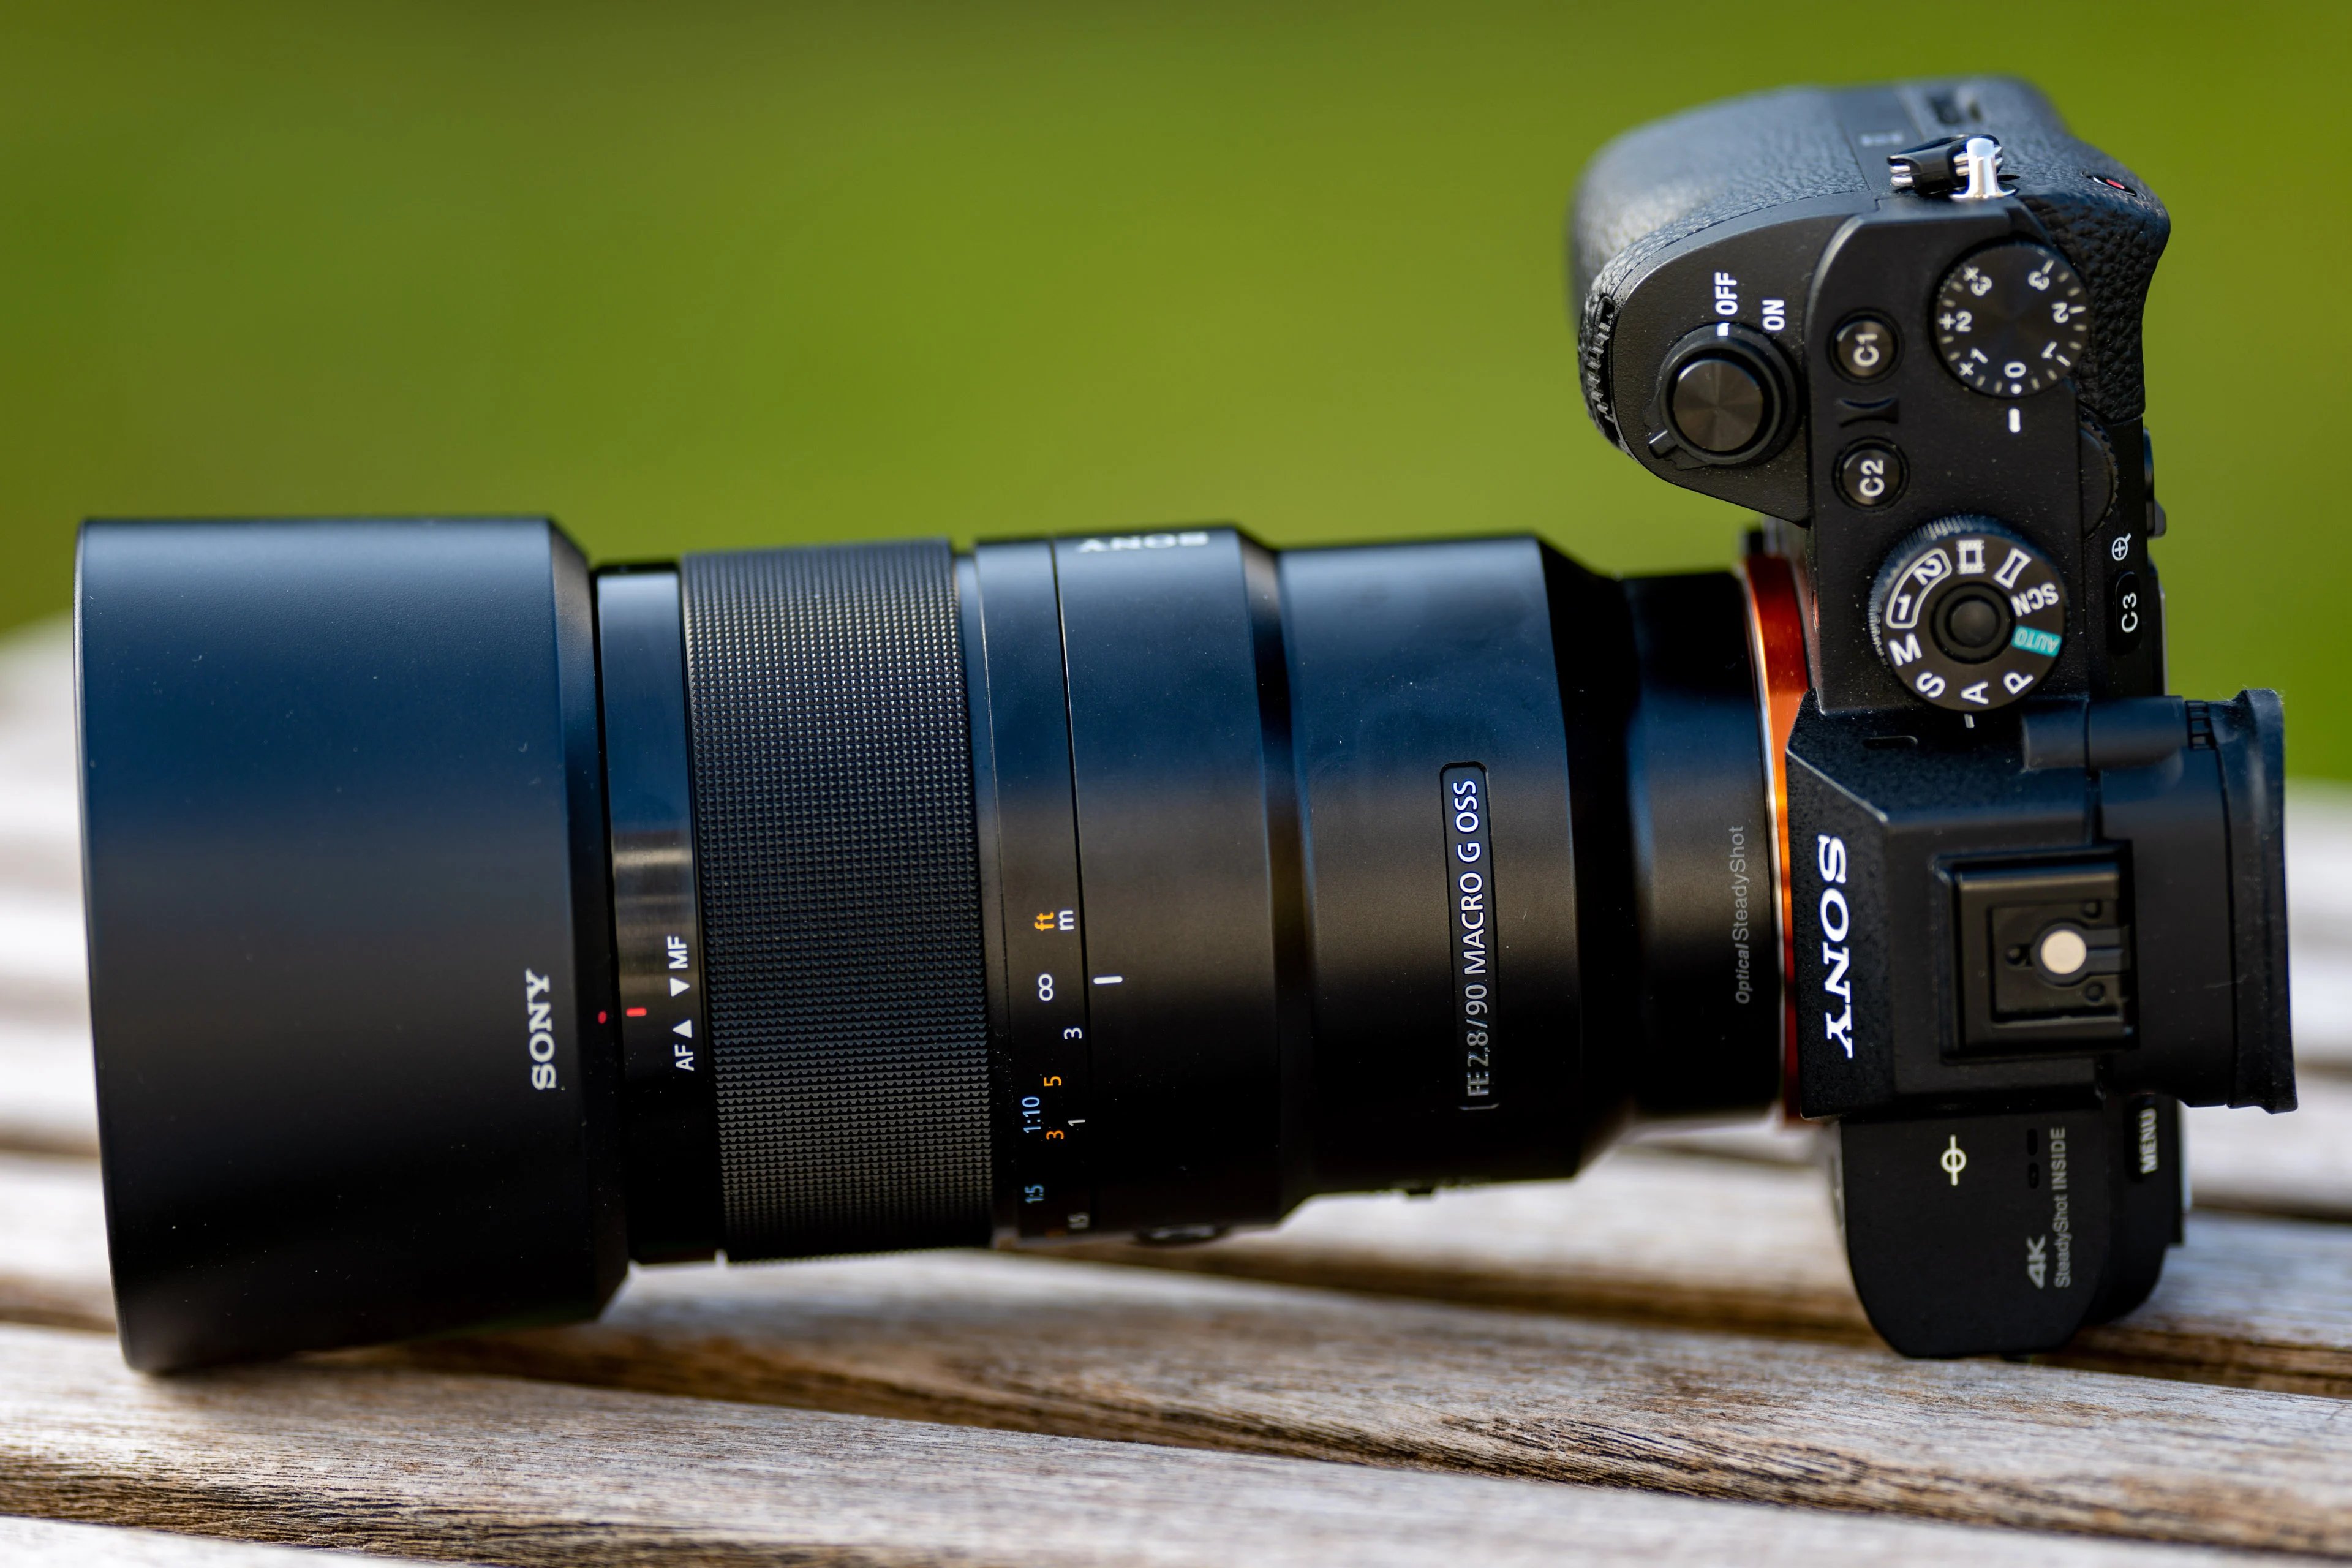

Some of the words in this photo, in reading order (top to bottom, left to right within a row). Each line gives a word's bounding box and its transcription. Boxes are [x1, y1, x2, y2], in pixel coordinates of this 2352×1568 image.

[1714, 271, 1738, 315] OFF
[1964, 267, 1992, 296] +3
[1762, 299, 1785, 331] ON
[1939, 311, 1972, 332] +2
[1853, 333, 1879, 368] C1
[1959, 348, 1989, 376] +1
[2004, 361, 2026, 379] 0
[1859, 459, 1885, 497] C2
[1913, 557, 1943, 586] 2
[1898, 593, 1912, 621] 1
[2010, 582, 2059, 617] SCN
[2121, 592, 2138, 633] C3
[1888, 633, 1923, 666] M
[2013, 628, 2060, 653] AUTO
[1916, 672, 1945, 698] S
[1961, 681, 1989, 704] A
[2003, 672, 2034, 695] P
[1453, 780, 1479, 832] OSS
[1457, 842, 1481, 862] G
[1034, 911, 1055, 932] ft
[1058, 910, 1074, 930] m
[1459, 872, 1486, 974] MACRO
[666, 935, 688, 969] MF
[1817, 834, 1853, 1059] SONY
[525, 968, 556, 1090] SONY
[1063, 1027, 1082, 1039] 3
[674, 1044, 695, 1071] AF
[1043, 1076, 1062, 1087] 5
[1466, 1071, 1489, 1096] FE
[1022, 1096, 1041, 1133] 1:10
[1046, 1130, 1065, 1140] 3
[2141, 1109, 2157, 1174] MENU
[2050, 1128, 2067, 1191] INSIDE
[2052, 1194, 2072, 1287] SteadyShot
[2027, 1235, 2046, 1289] 4K
